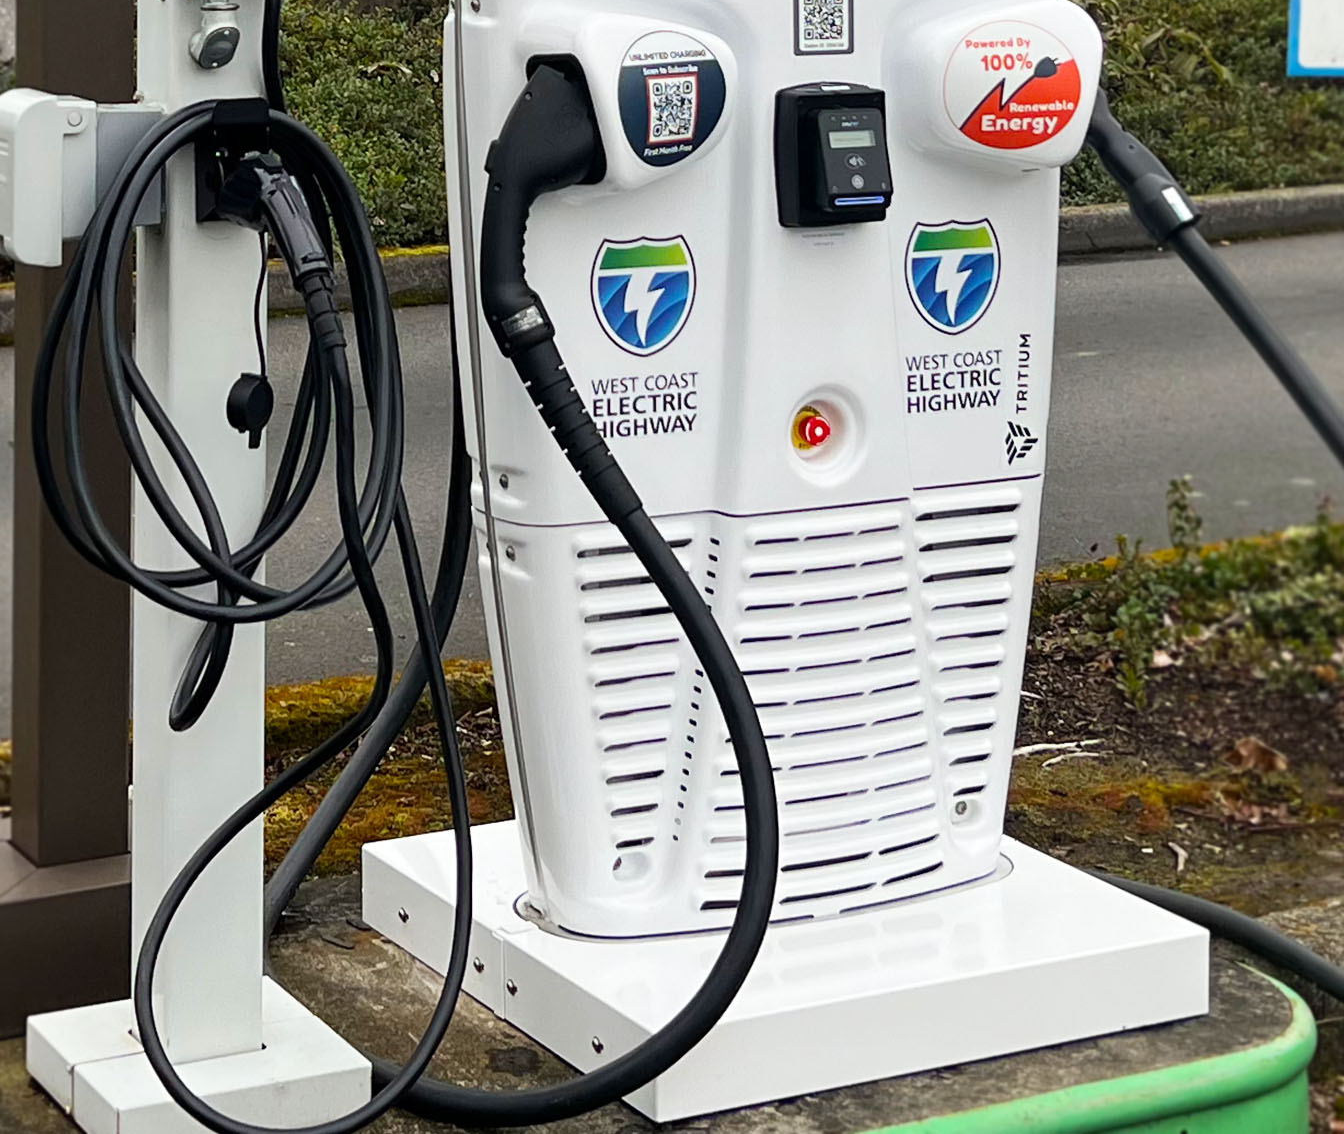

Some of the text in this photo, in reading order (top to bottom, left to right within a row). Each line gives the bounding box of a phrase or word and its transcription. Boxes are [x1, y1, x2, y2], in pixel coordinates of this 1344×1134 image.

[965, 37, 1031, 50] Powered By
[629, 50, 706, 62] UNLIMITED CHARGING
[980, 53, 1033, 72] 100%
[1009, 98, 1075, 113] Renewable
[980, 113, 1059, 135] Energy
[905, 349, 1003, 371] WEST COAST
[592, 371, 699, 395] WEST COAST
[907, 368, 1002, 393] ELECTRIC
[1016, 333, 1032, 414] TRITIUM
[593, 392, 698, 417] ELECTRIC
[907, 390, 1001, 414] HIGHWAY
